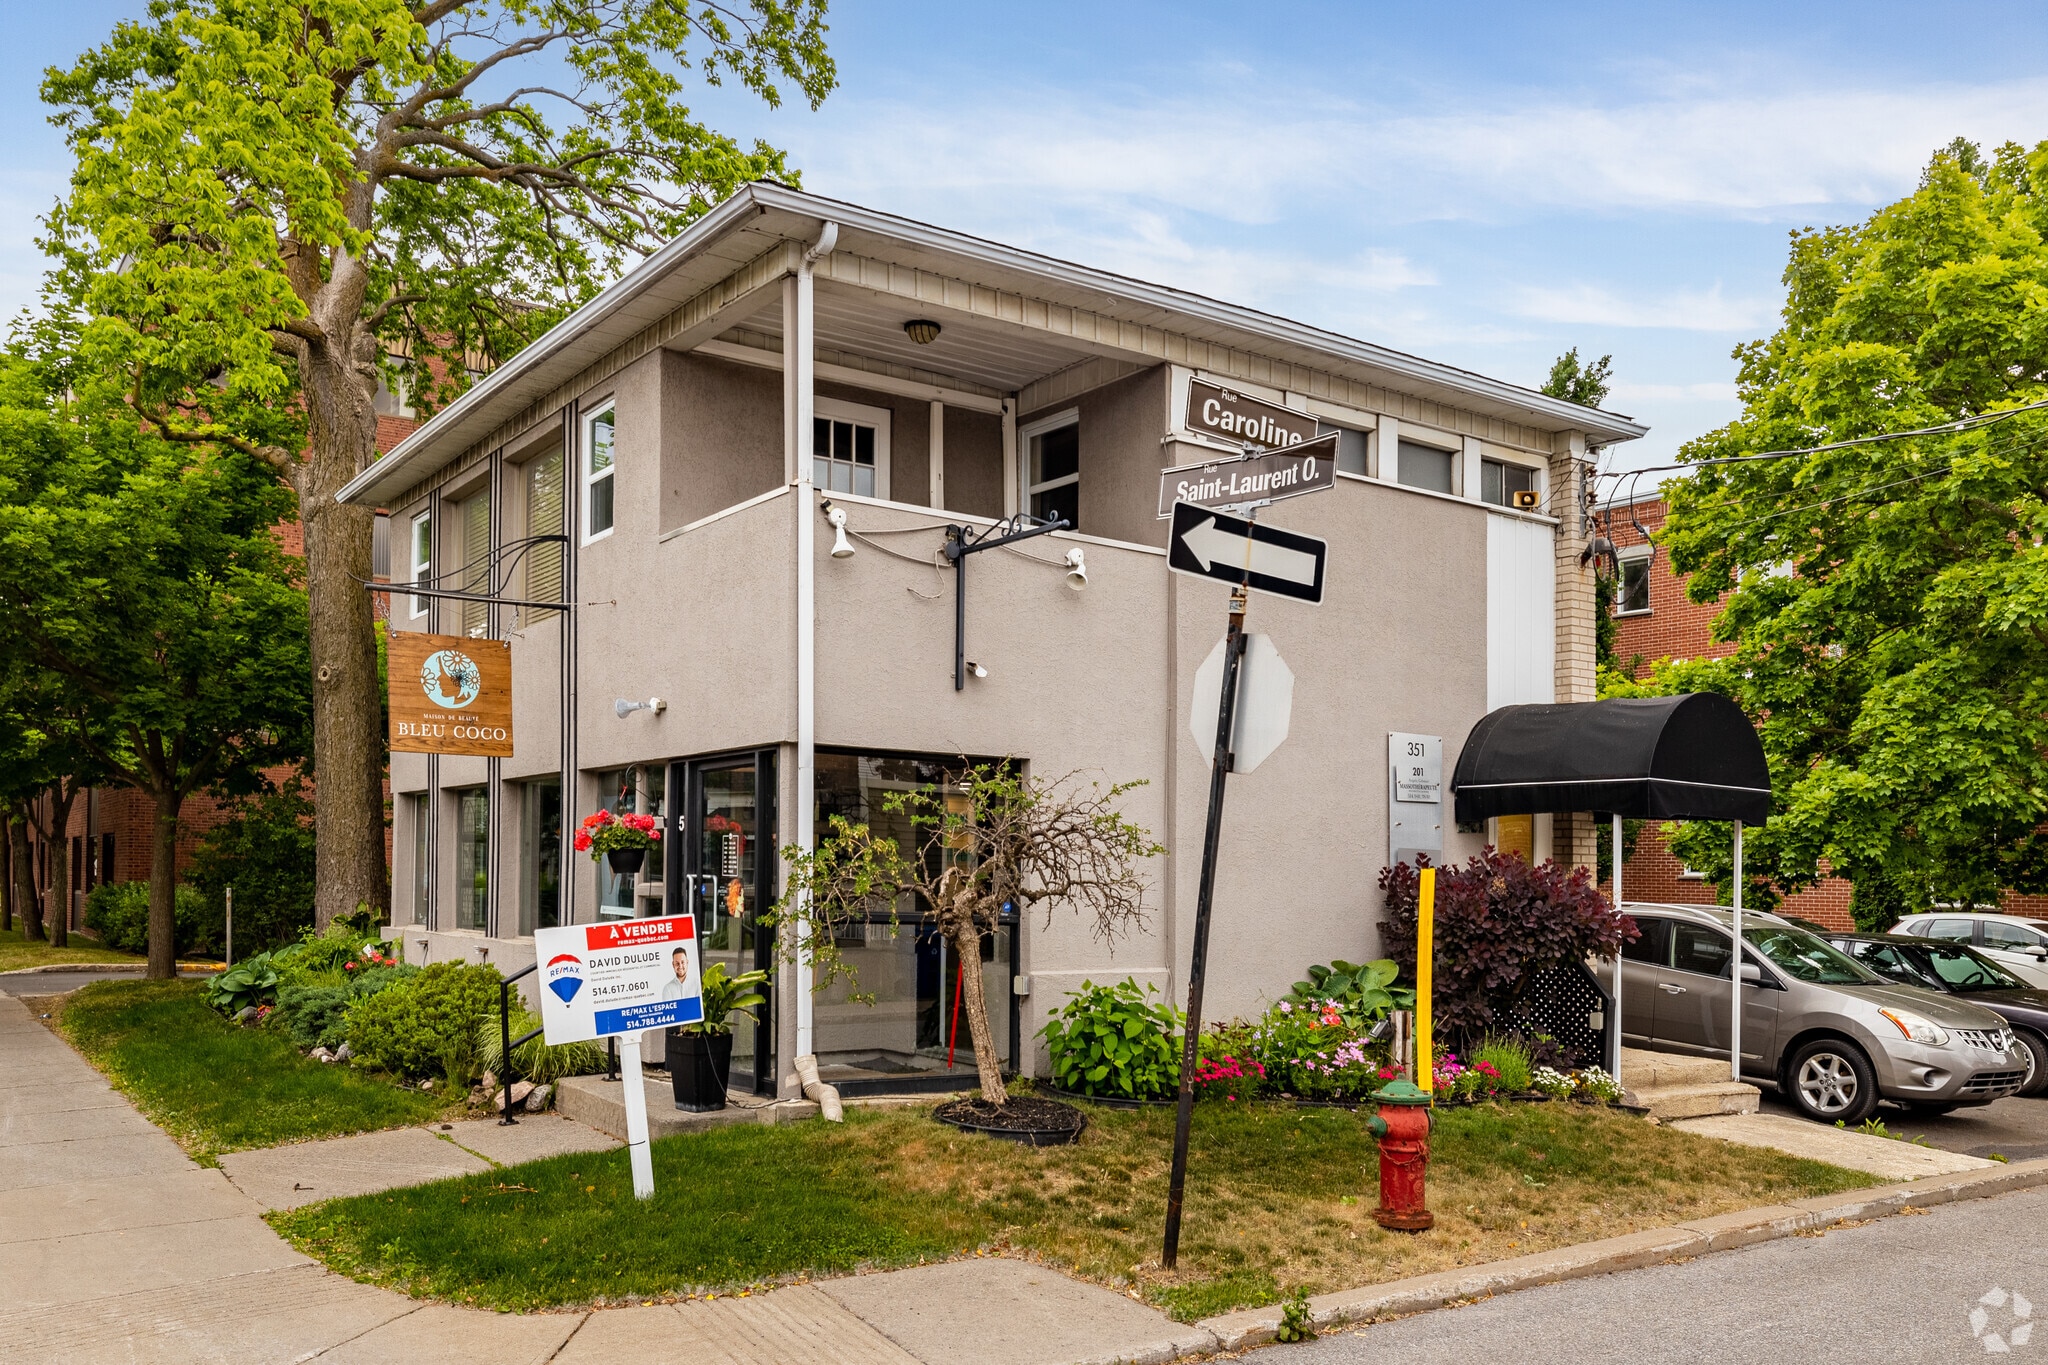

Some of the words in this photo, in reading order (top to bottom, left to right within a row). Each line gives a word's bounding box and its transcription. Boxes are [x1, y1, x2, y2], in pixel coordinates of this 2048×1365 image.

[1221, 390, 1237, 403] Rue
[1203, 399, 1302, 447] Caroline
[1204, 464, 1217, 474] Rue
[1175, 463, 1298, 501] Saint-Laurent
[1303, 456, 1319, 481] O.
[398, 723, 445, 737] BLEU
[453, 726, 506, 740] COCO
[1407, 742, 1424, 757] 351
[1413, 767, 1424, 776] 201
[679, 815, 684, 831] 5
[610, 926, 619, 939] À
[623, 922, 673, 937] VENDRE
[618, 934, 669, 945] remax-quebec.com
[590, 957, 620, 968] DAVID
[624, 952, 660, 963] DULUDE
[550, 966, 580, 977] RE/MAX
[592, 981, 649, 996] 514.617.0601
[622, 1006, 647, 1017] RE/MAX
[649, 1002, 677, 1012] L'ESPACE
[627, 1014, 675, 1029] 514.788.4444
